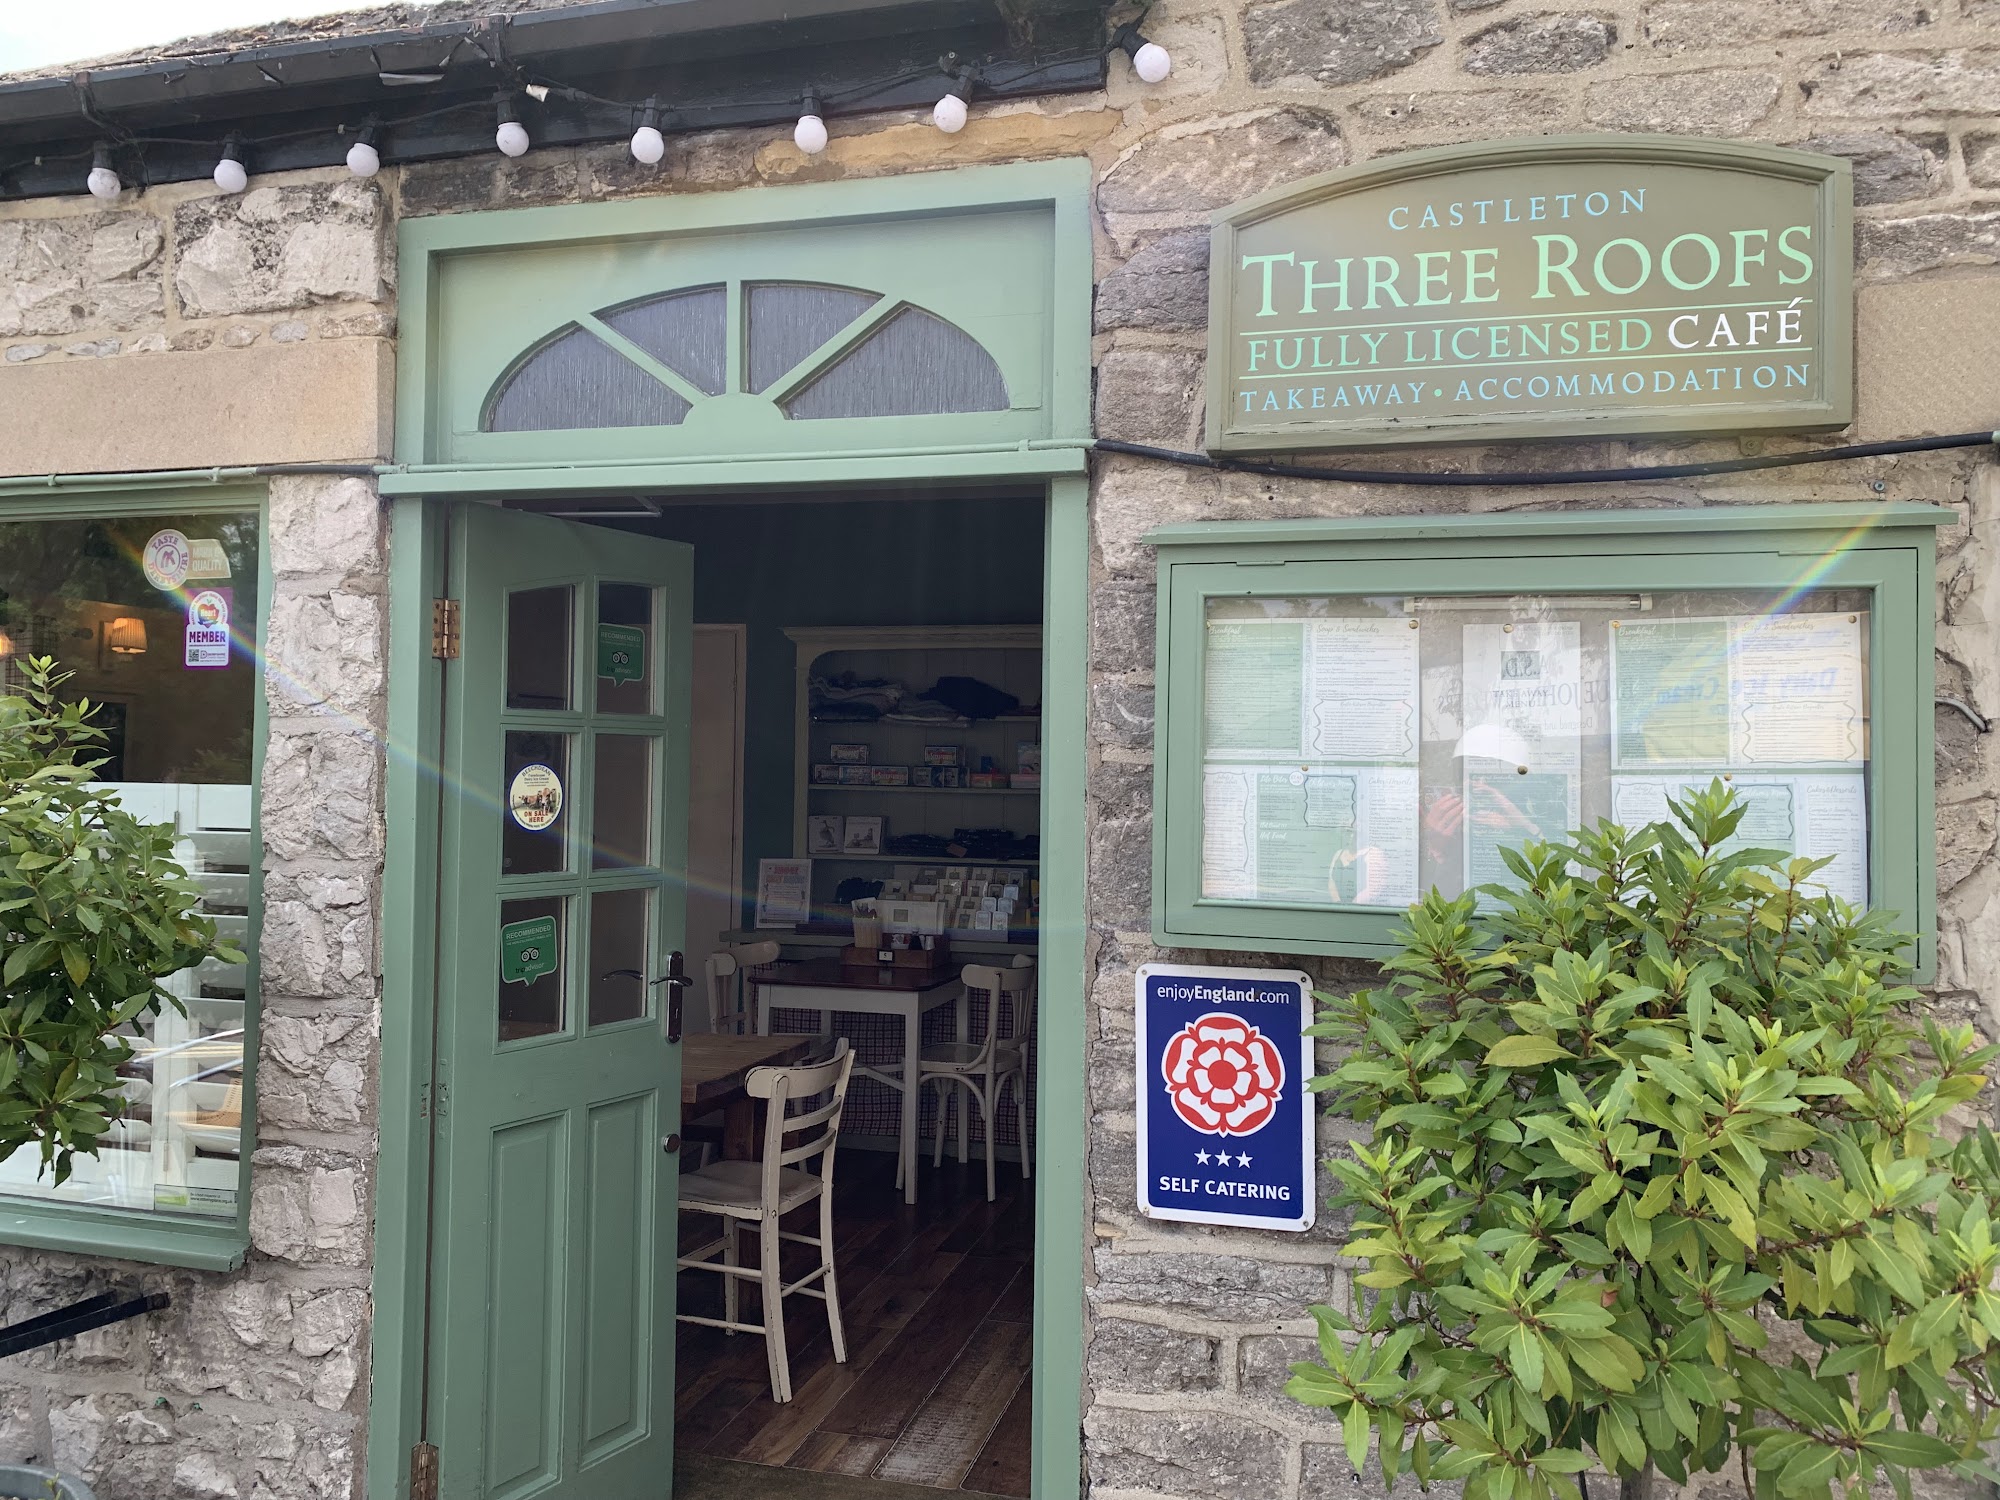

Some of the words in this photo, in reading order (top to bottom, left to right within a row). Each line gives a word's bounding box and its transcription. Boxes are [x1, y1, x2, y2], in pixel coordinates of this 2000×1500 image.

[1388, 188, 1647, 231] CASTLETON
[1241, 247, 1501, 318] THREE
[1531, 224, 1815, 301] ROOFS
[1247, 331, 1388, 372] FULLY
[1404, 317, 1653, 363] LICENSED
[1667, 296, 1804, 350] CAFÉ
[1240, 381, 1428, 413] TAKEAWAY
[1455, 363, 1811, 403] ACCOMMODATION
[151, 535, 178, 550] TASTE
[192, 560, 223, 572] QUALITY
[1208, 625, 1242, 636] Breakfast
[1342, 623, 1380, 634] Sandwiches
[1619, 626, 1656, 638] Breakfast
[1771, 620, 1815, 631] Sandwiches
[188, 631, 226, 643] MEMBER
[600, 632, 641, 642] RECOMMENDED
[506, 925, 552, 940] RECOMMENDED
[515, 963, 545, 974] tripadvisor
[1157, 984, 1291, 1005] enjoyEngland.com
[1159, 1176, 1200, 1194] SELF
[1204, 1180, 1291, 1201] CATERING
